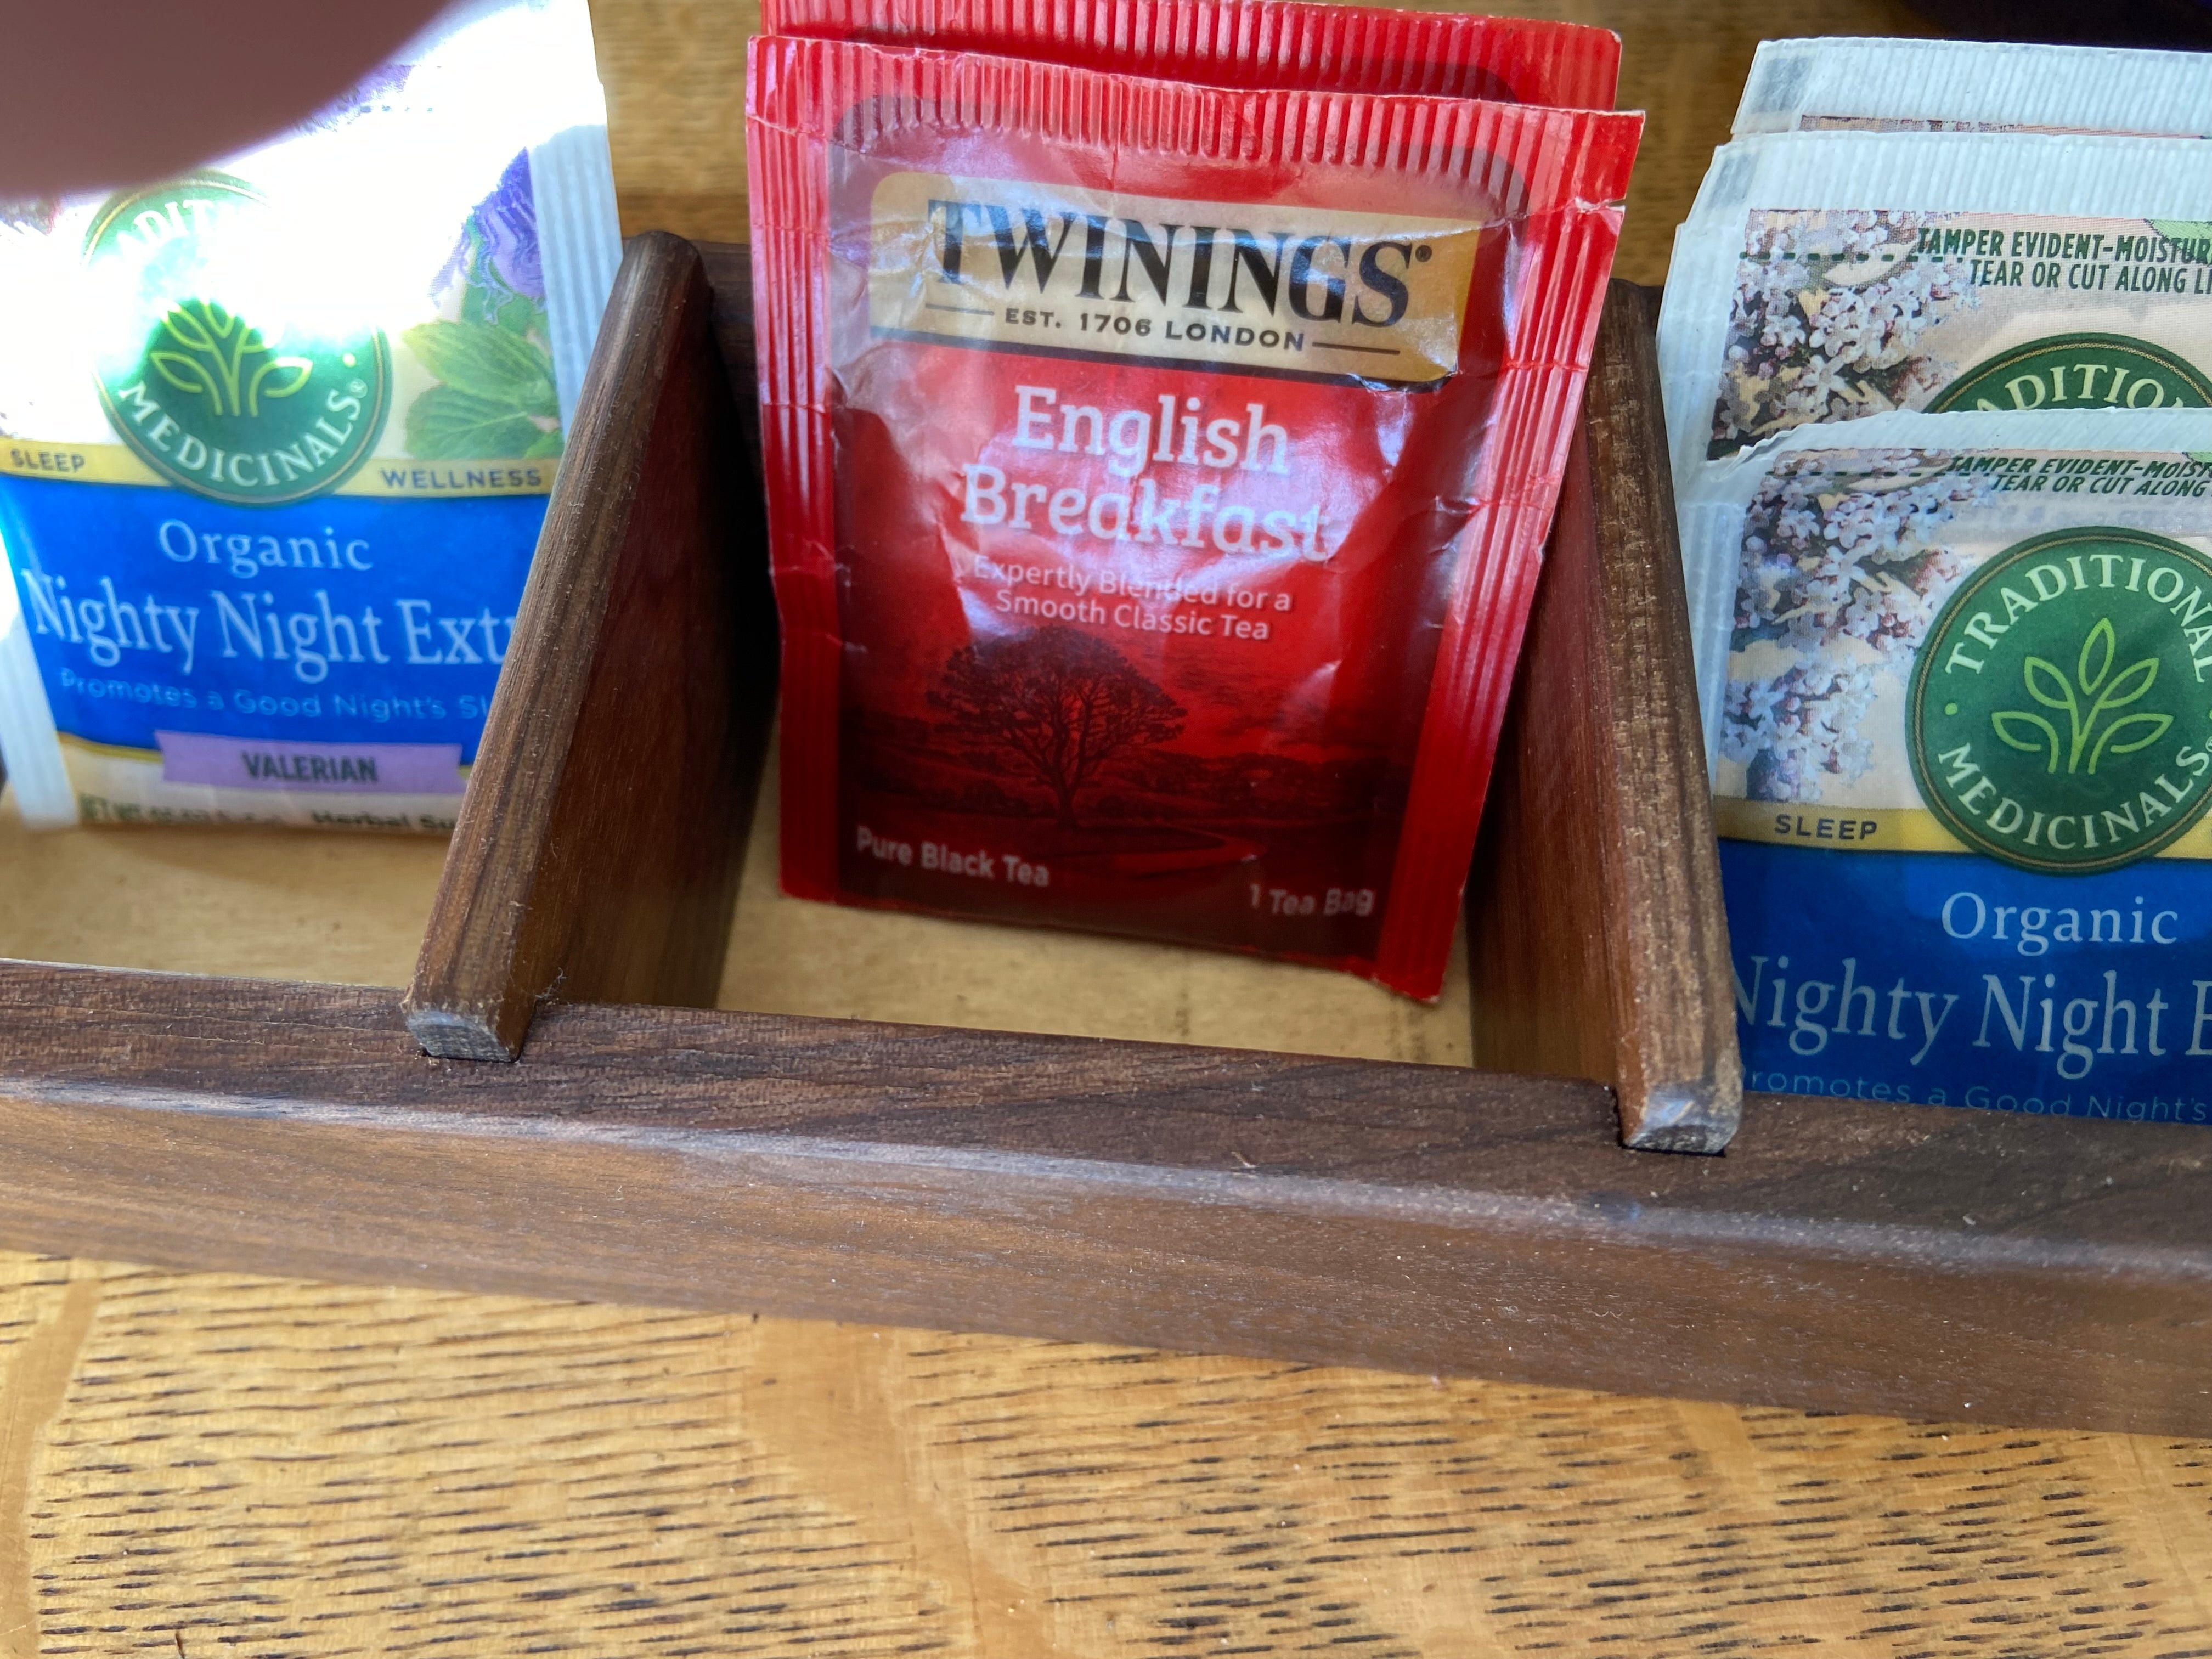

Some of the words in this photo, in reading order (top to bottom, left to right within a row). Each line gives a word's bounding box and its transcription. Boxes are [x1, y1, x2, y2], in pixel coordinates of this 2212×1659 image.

[1918, 227, 2001, 258] TAMPER
[2012, 232, 2212, 266] EVIDENT-MOISTUR
[1970, 260, 2023, 287] TEAR
[2032, 262, 2061, 287] OR
[2068, 264, 2109, 290] CUT
[2115, 266, 2186, 294] ALONG
[1005, 307, 1061, 330] EST.
[1079, 312, 1150, 337] 1706
[1166, 319, 1304, 352] LONDON
[1012, 385, 1288, 477] English
[10, 449, 85, 473] SLEEP
[381, 467, 541, 489] WELLNESS
[1947, 456, 2038, 473] TAMPER
[2042, 458, 2212, 478] EVIDENT-MOIST
[1991, 475, 2049, 492] TEAR
[2052, 476, 2085, 493] OR
[2090, 477, 2134, 494] CUT
[2134, 480, 2209, 497] ALONG
[961, 464, 1329, 562] Breakfast
[159, 519, 373, 579] Organic
[973, 554, 1093, 597] Expertly
[1098, 571, 1218, 606] Blended
[1227, 580, 1269, 610] for
[1275, 591, 1293, 611] a
[21, 568, 201, 675] Nighty
[211, 589, 391, 683] Night
[997, 589, 1105, 624] Smooth
[1114, 603, 1212, 636] Classic
[1220, 614, 1270, 641] Tea
[1945, 554, 2212, 682] TRADITIONAL
[60, 668, 198, 709] Promotes
[208, 692, 224, 710] a
[234, 690, 321, 718] Good
[334, 692, 447, 722] Night's
[242, 751, 378, 783] VALERIAN
[1775, 814, 1877, 840] SLEEP
[857, 826, 912, 865] Pure
[921, 840, 994, 878] Black
[1002, 854, 1049, 887] Tea
[1248, 883, 1261, 908] 1
[1268, 888, 1314, 915] Tea
[1323, 888, 1374, 916] Bag
[1942, 891, 2178, 956] Organic
[1733, 956, 1960, 1065] Nighty
[1973, 969, 2169, 1079] Night
[1752, 1071, 1912, 1104] romotes
[1928, 1087, 1946, 1105] a
[1965, 1086, 2072, 1116] Good
[2088, 1095, 2207, 1122] Night's
